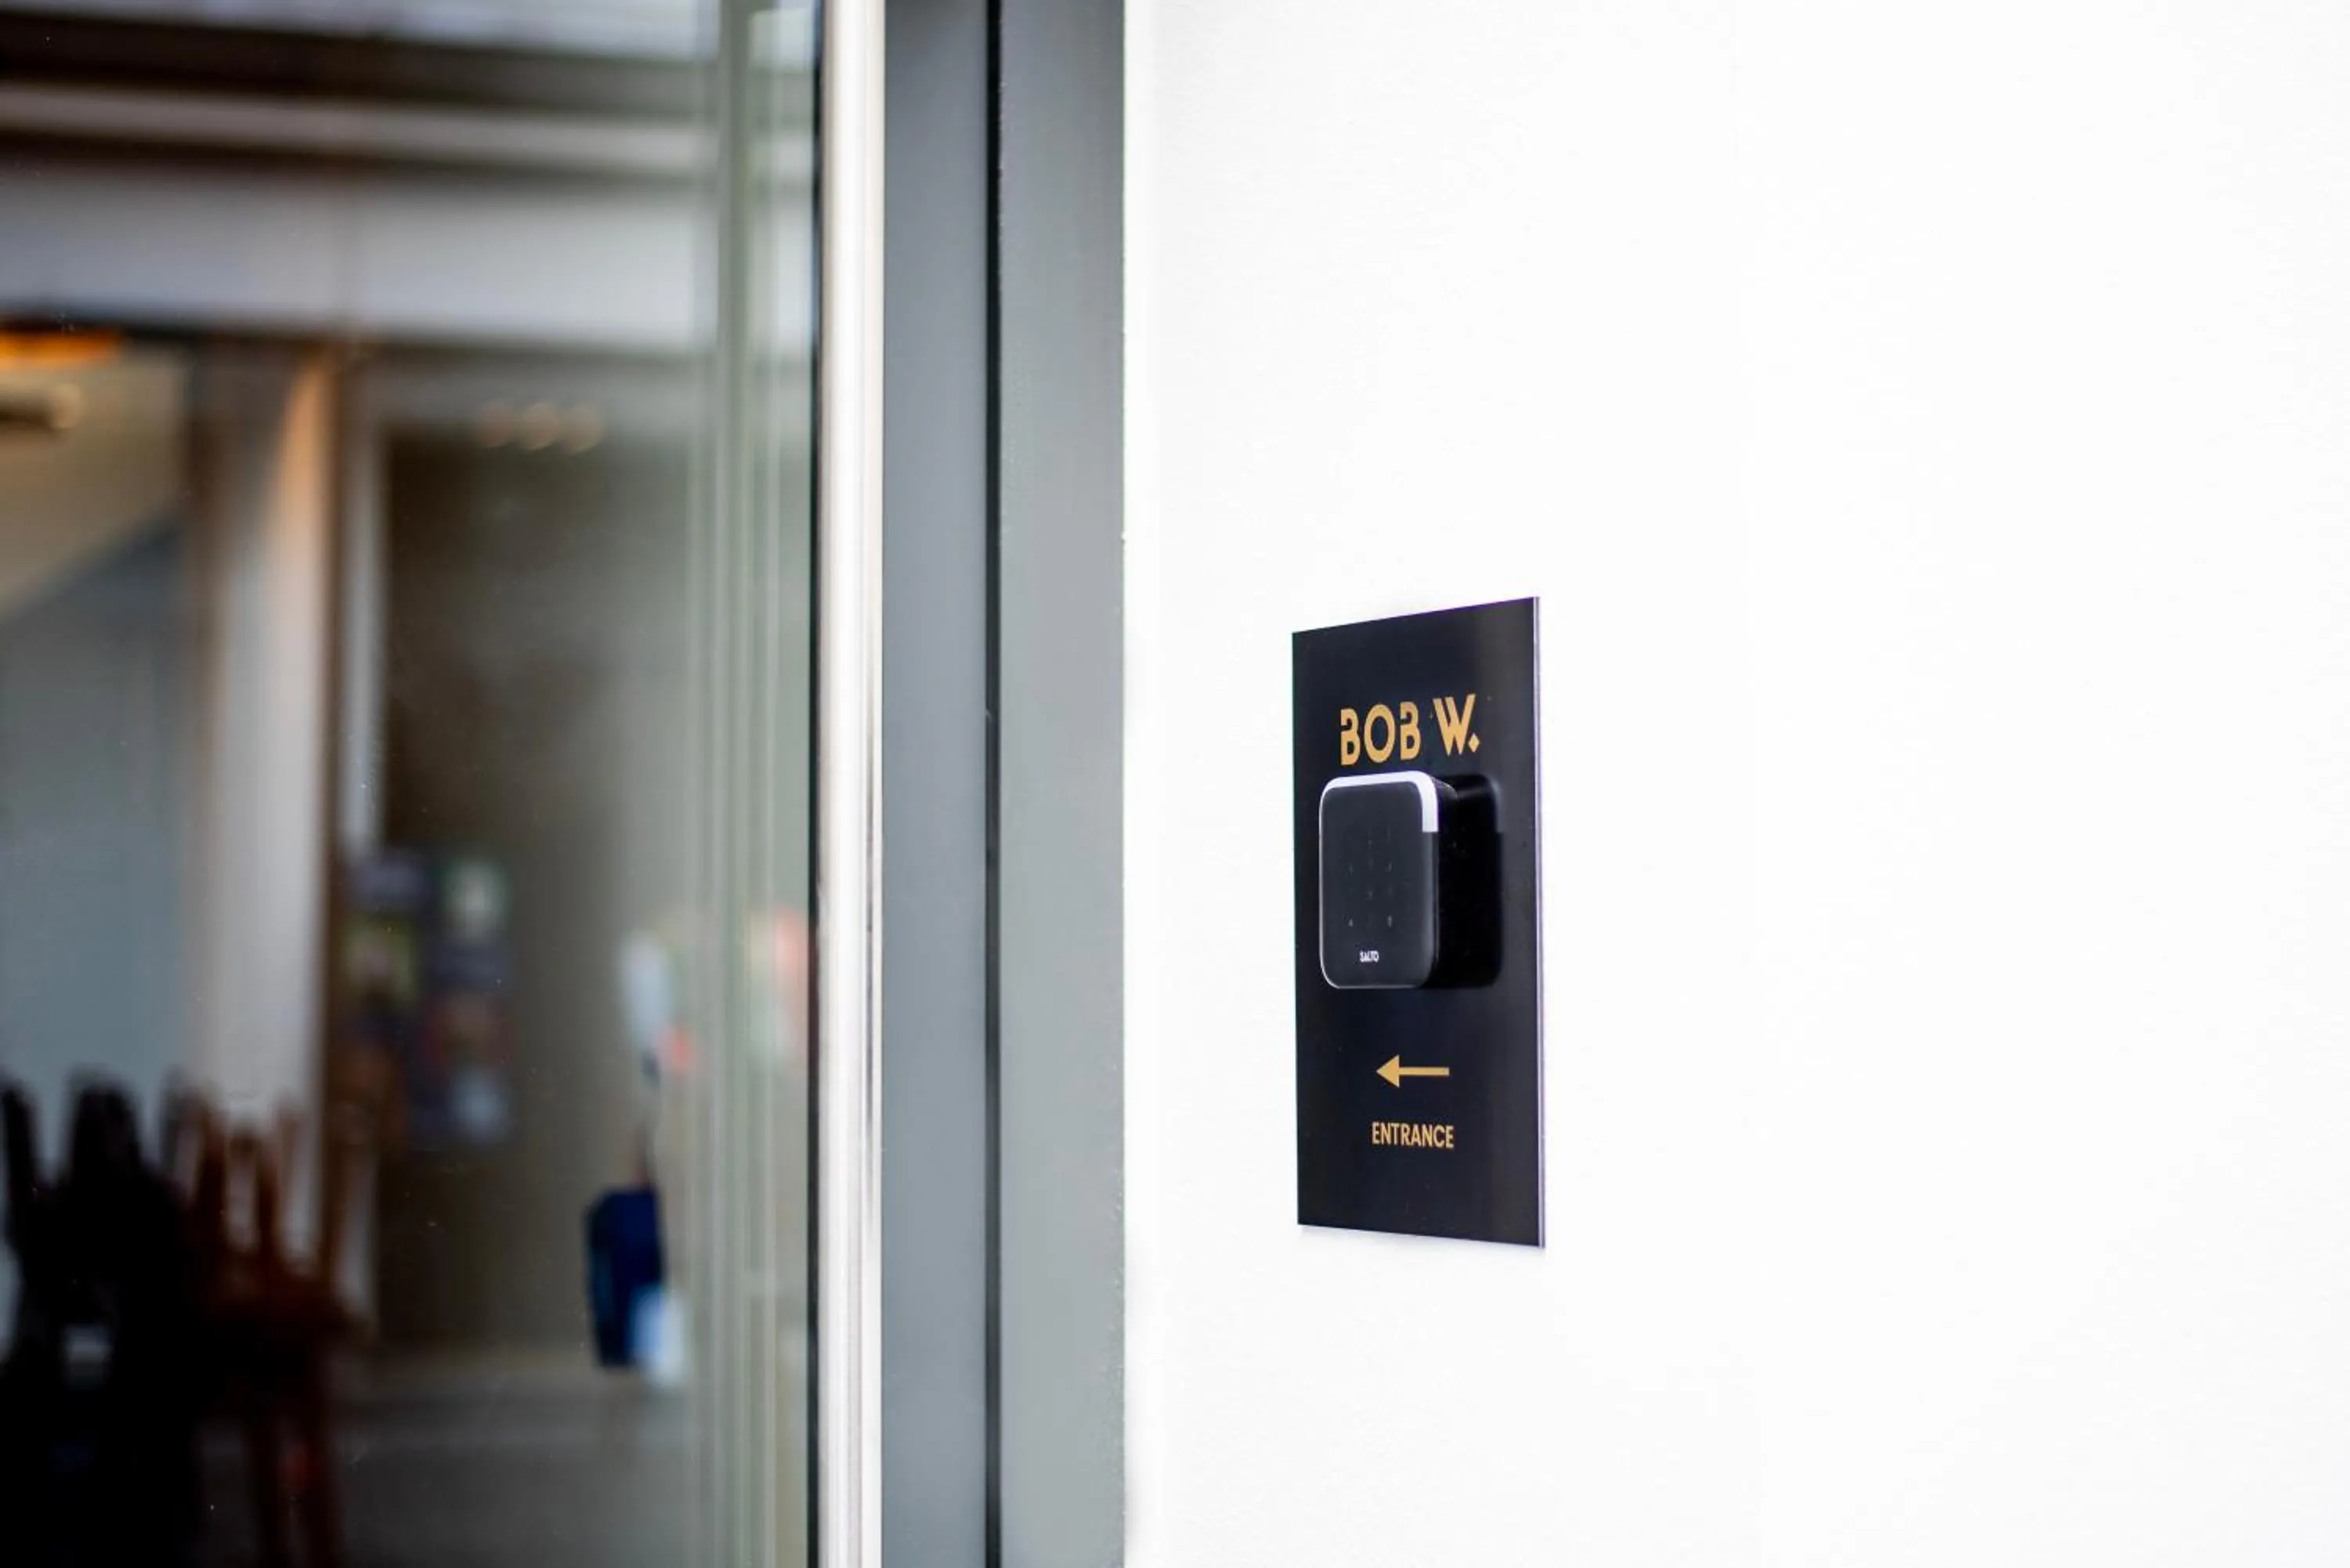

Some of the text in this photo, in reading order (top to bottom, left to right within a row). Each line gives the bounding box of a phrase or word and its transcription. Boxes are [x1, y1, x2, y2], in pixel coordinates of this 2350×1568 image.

[1340, 693, 1480, 765] BOB W.
[1359, 950, 1379, 963] SALTO
[1372, 1122, 1455, 1149] ENTRANCE
